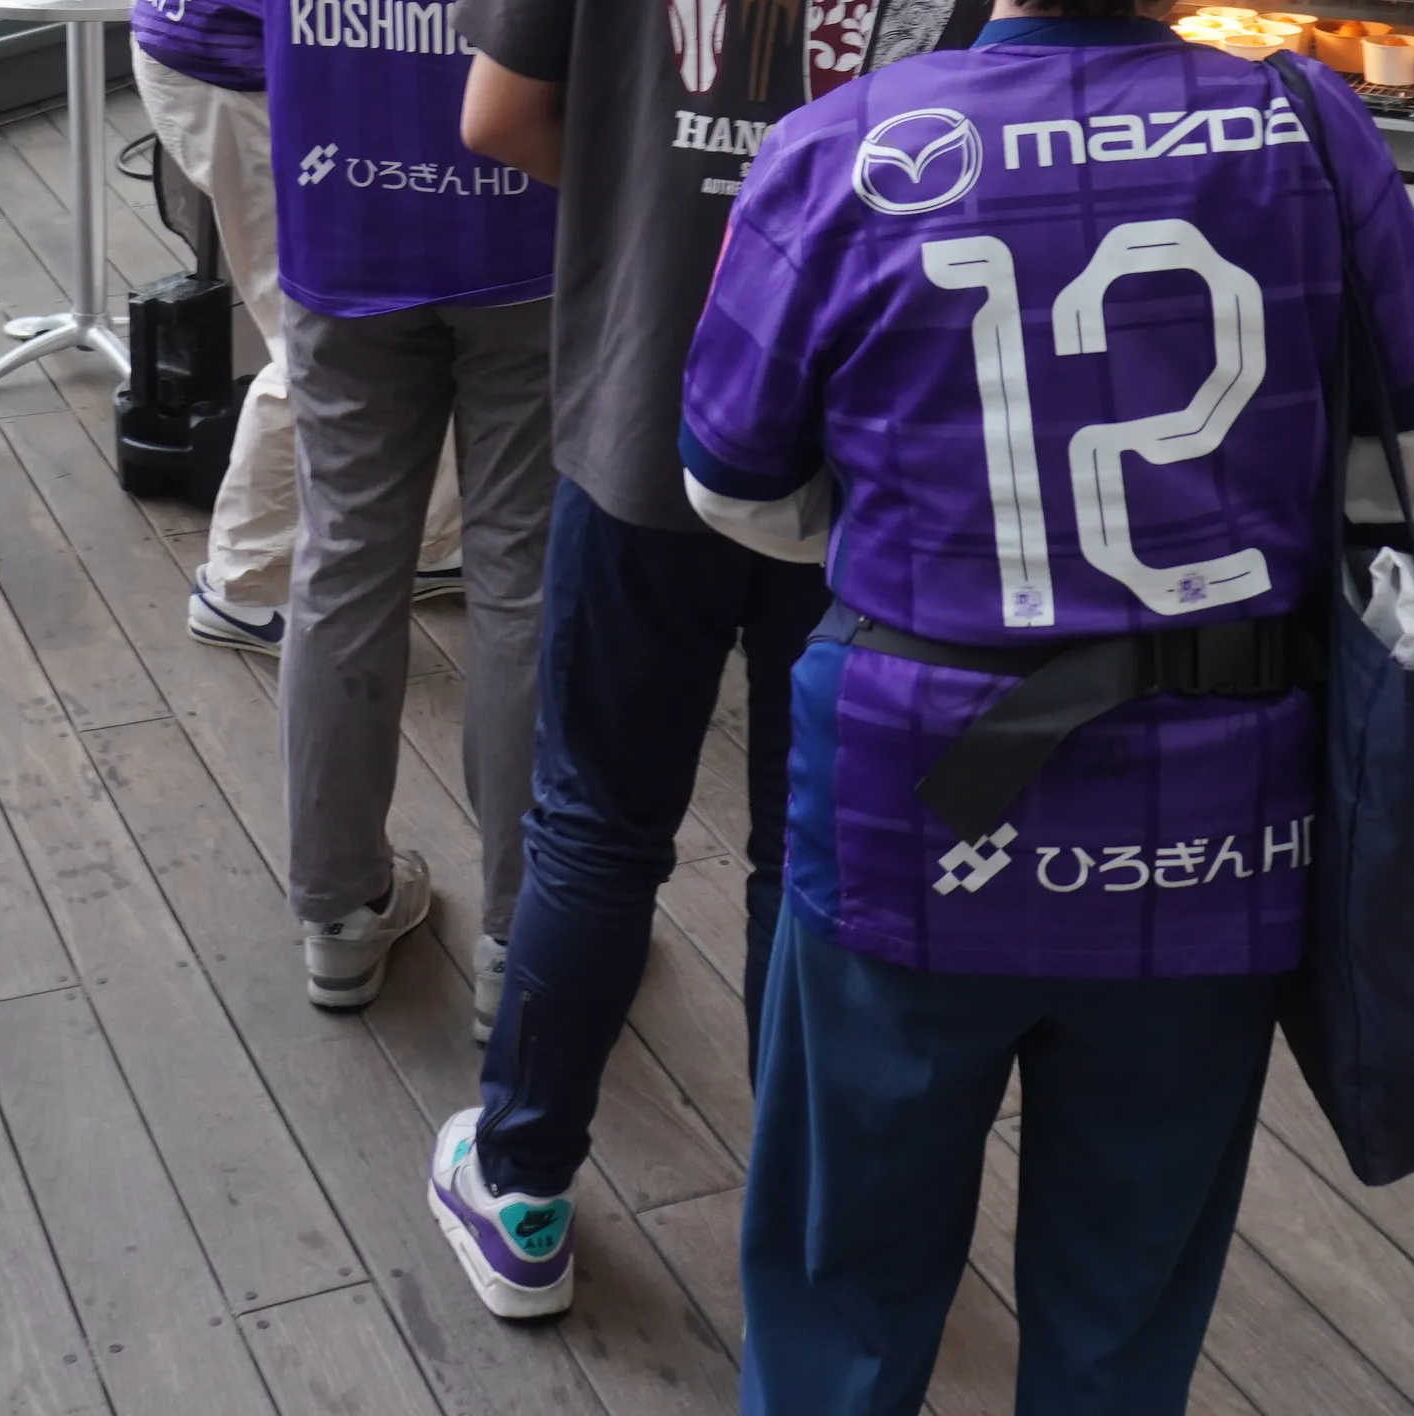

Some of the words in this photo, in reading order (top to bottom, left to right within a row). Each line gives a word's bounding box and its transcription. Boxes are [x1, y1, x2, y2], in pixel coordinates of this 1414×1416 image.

[671, 109, 778, 158] HAN
[1002, 96, 1311, 171] mazda
[921, 217, 1273, 628] 12
